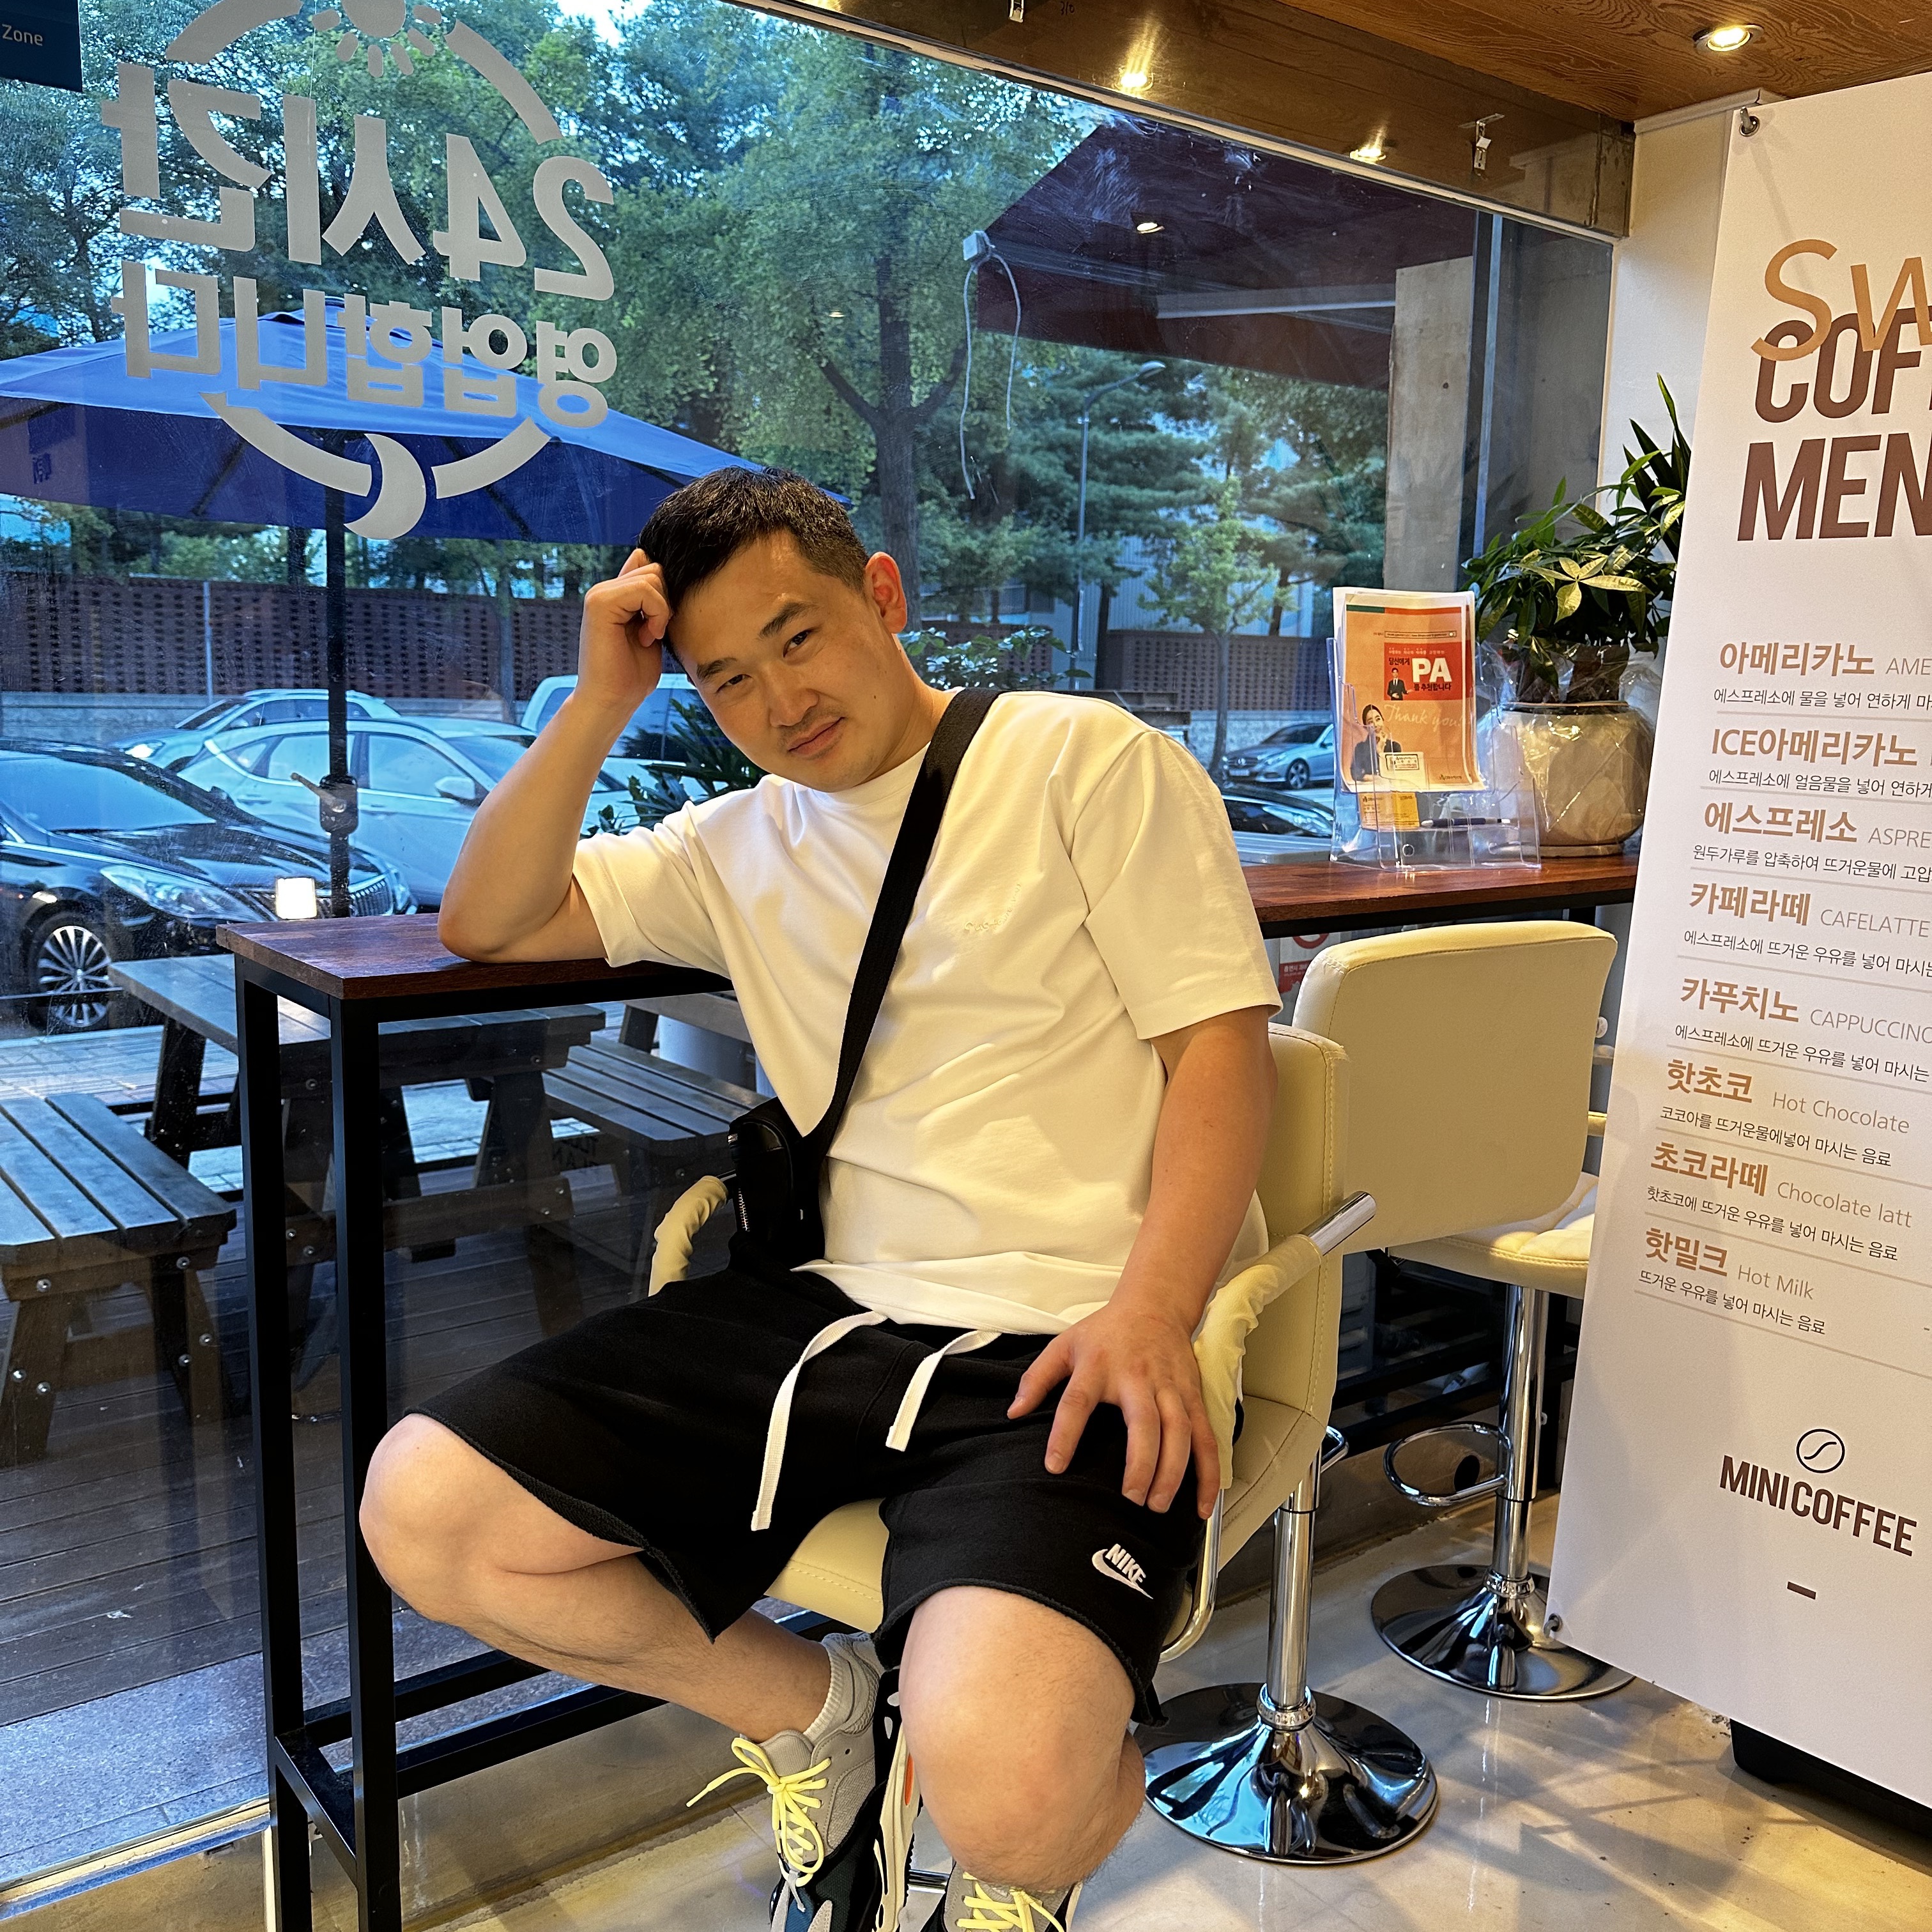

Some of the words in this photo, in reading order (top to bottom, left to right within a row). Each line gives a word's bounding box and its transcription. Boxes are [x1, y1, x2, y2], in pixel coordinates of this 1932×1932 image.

[2, 23, 43, 47] Zone
[1755, 305, 1932, 423] COF
[1411, 657, 1452, 683] PA
[1720, 641, 1875, 677] 아메리카노
[1422, 682, 1452, 691] 추천합니다
[1713, 688, 1795, 707] 에스프레소에
[1800, 689, 1828, 708] 물을
[1834, 693, 1862, 709] 넣어
[1867, 693, 1911, 710] 연하게
[1916, 695, 1932, 712] 마
[1384, 704, 1428, 724] Thank
[1712, 728, 1918, 767] ICE아메리카노
[1709, 769, 1790, 789] 에스프레소에
[1795, 774, 1851, 793] 얼음물을
[1857, 778, 1885, 796] 넣어
[1705, 802, 1858, 843] 에스프레소
[1693, 845, 1759, 866] 원두가루를
[1764, 851, 1819, 871] 압축하여
[1823, 857, 1897, 880] 뜨거운물에
[1689, 882, 1811, 926] 카페라떼
[1820, 908, 1930, 938] CAFELATTE
[1684, 930, 1763, 954] 에스프레소에
[1767, 941, 1809, 961] 뜨거운
[1813, 946, 1857, 967] 우유를
[1862, 953, 1890, 972] 넣어
[1680, 978, 1799, 1023] 카푸치노
[1675, 1025, 1754, 1052] 에스프레소에
[1757, 1038, 1799, 1059] 뜨거운
[1802, 1046, 1846, 1067] 우유를
[1851, 1054, 1880, 1075] 넣어
[1884, 1061, 1930, 1082] 마시는
[1667, 1059, 1753, 1103] 핫초코
[1772, 1091, 1806, 1114] Hot
[1813, 1100, 1910, 1133] Chocolate
[1660, 1107, 1712, 1129] 코코아를
[1715, 1117, 1811, 1151] 뜨거운물에넣어
[1815, 1137, 1858, 1160] 마시는
[1862, 1147, 1892, 1167] 음료
[1650, 1142, 1768, 1197] 초코라떼
[1777, 1182, 1871, 1218] Chocolate
[1879, 1203, 1912, 1228] latt
[1647, 1185, 1697, 1212] 핫초코에
[1700, 1200, 1740, 1223] 뜨거운
[1744, 1211, 1785, 1234] 우유를
[1789, 1221, 1817, 1241] 넣어
[1821, 1230, 1864, 1254] 마시는
[1868, 1241, 1898, 1261] 음료
[1645, 1227, 1728, 1277] 핫밀크
[1738, 1264, 1770, 1289] Hot
[1777, 1275, 1814, 1300] Milk
[1638, 1270, 1677, 1292] 뜨거운
[1680, 1282, 1719, 1305] 우유를
[1722, 1293, 1748, 1314] 넣어
[1752, 1303, 1793, 1326] 마시는
[1797, 1315, 1826, 1335] 음료
[1105, 1543, 1146, 1587] NIKE
